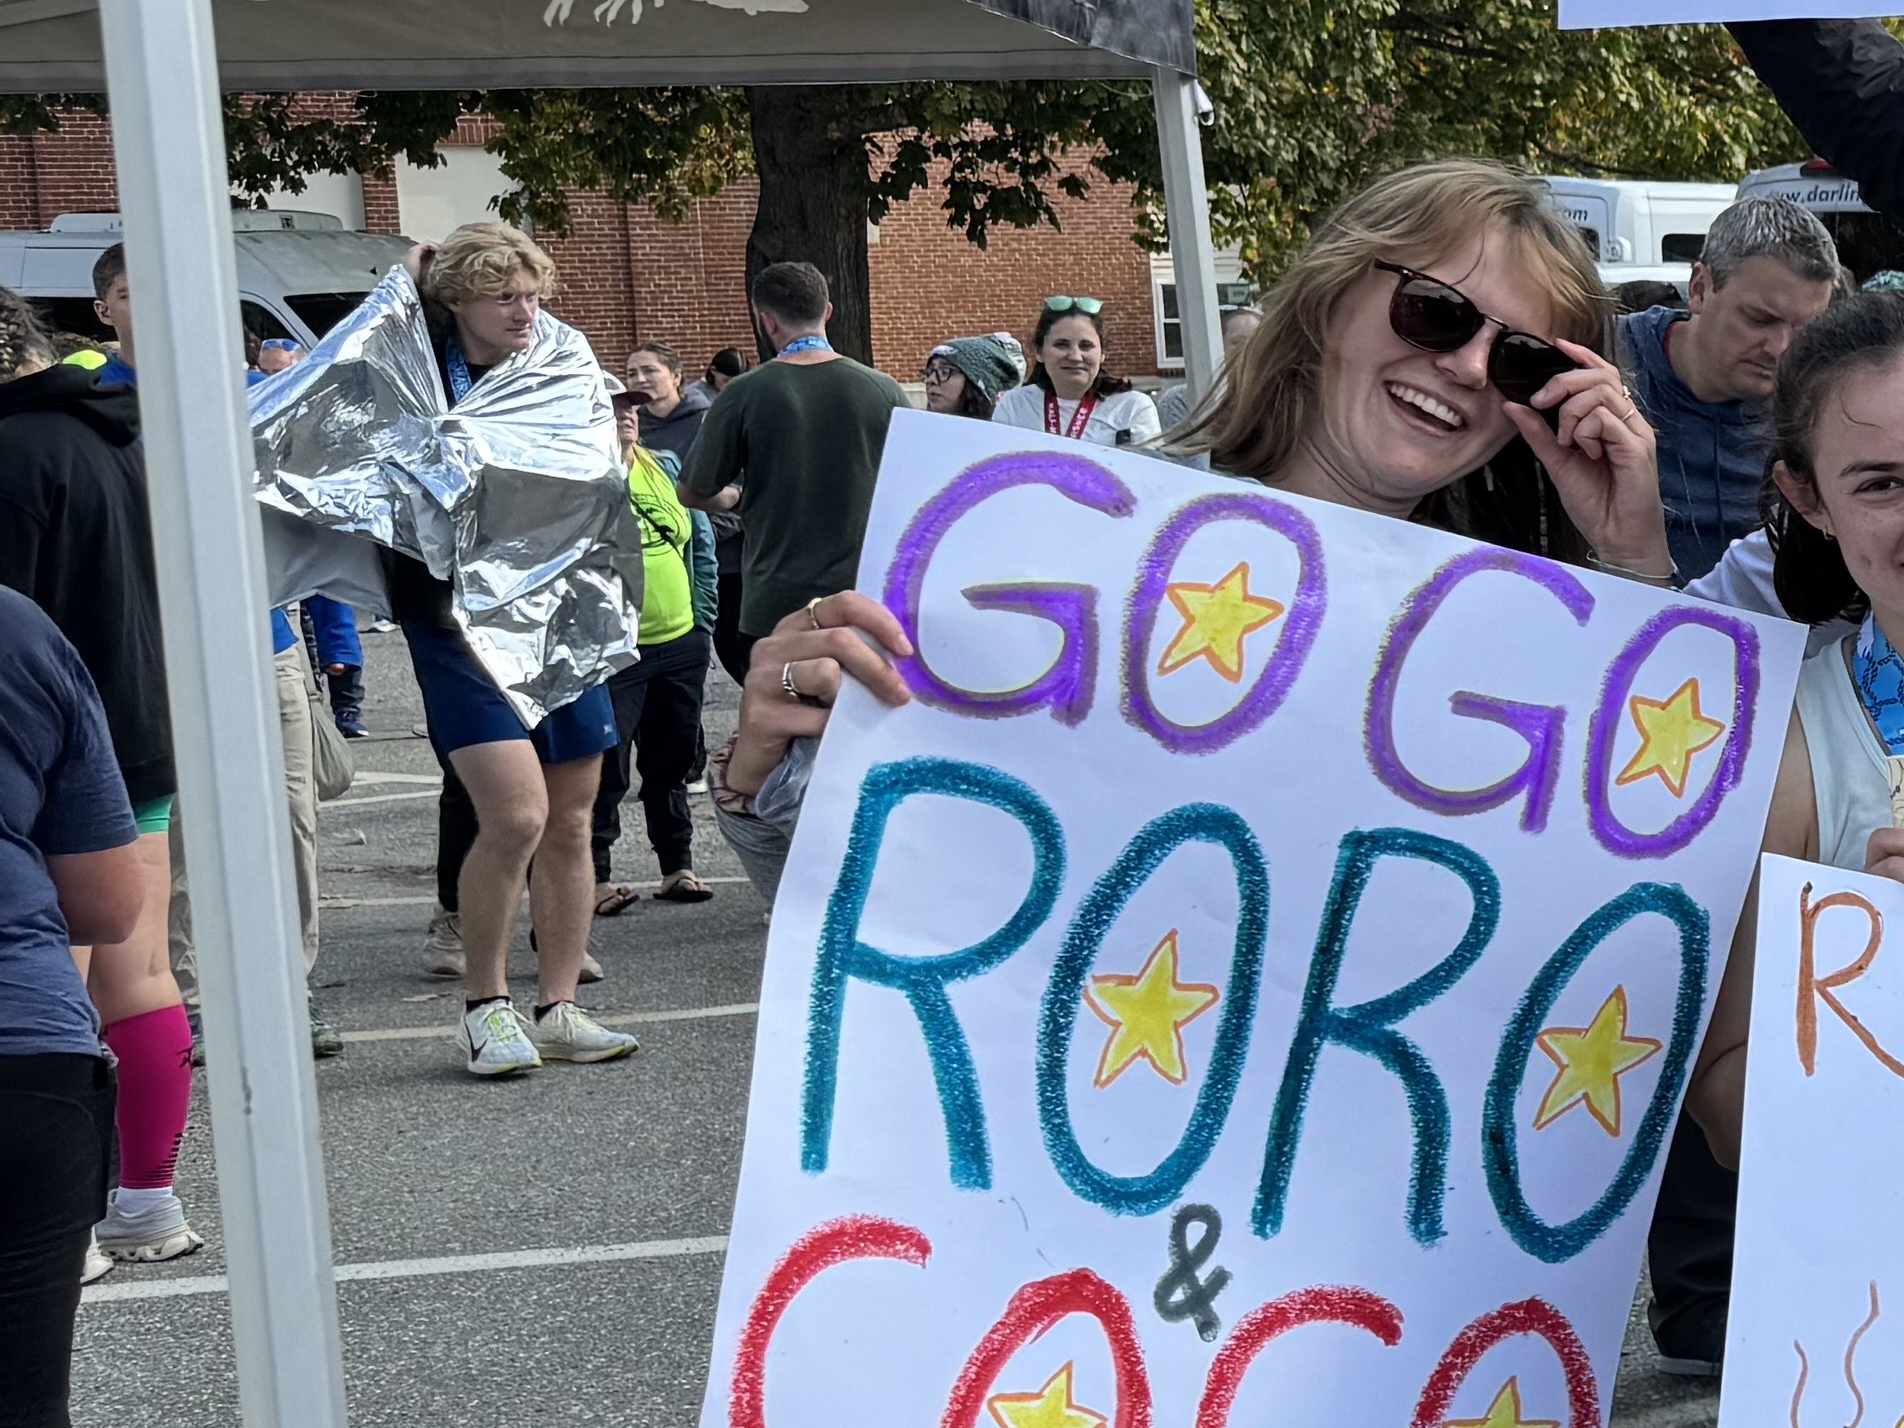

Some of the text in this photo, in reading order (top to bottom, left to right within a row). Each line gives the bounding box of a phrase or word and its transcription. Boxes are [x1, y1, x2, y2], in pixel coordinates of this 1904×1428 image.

[882, 448, 1762, 859] GO GO
[799, 755, 1711, 1266] RORO
[1152, 1203, 1232, 1341] &
